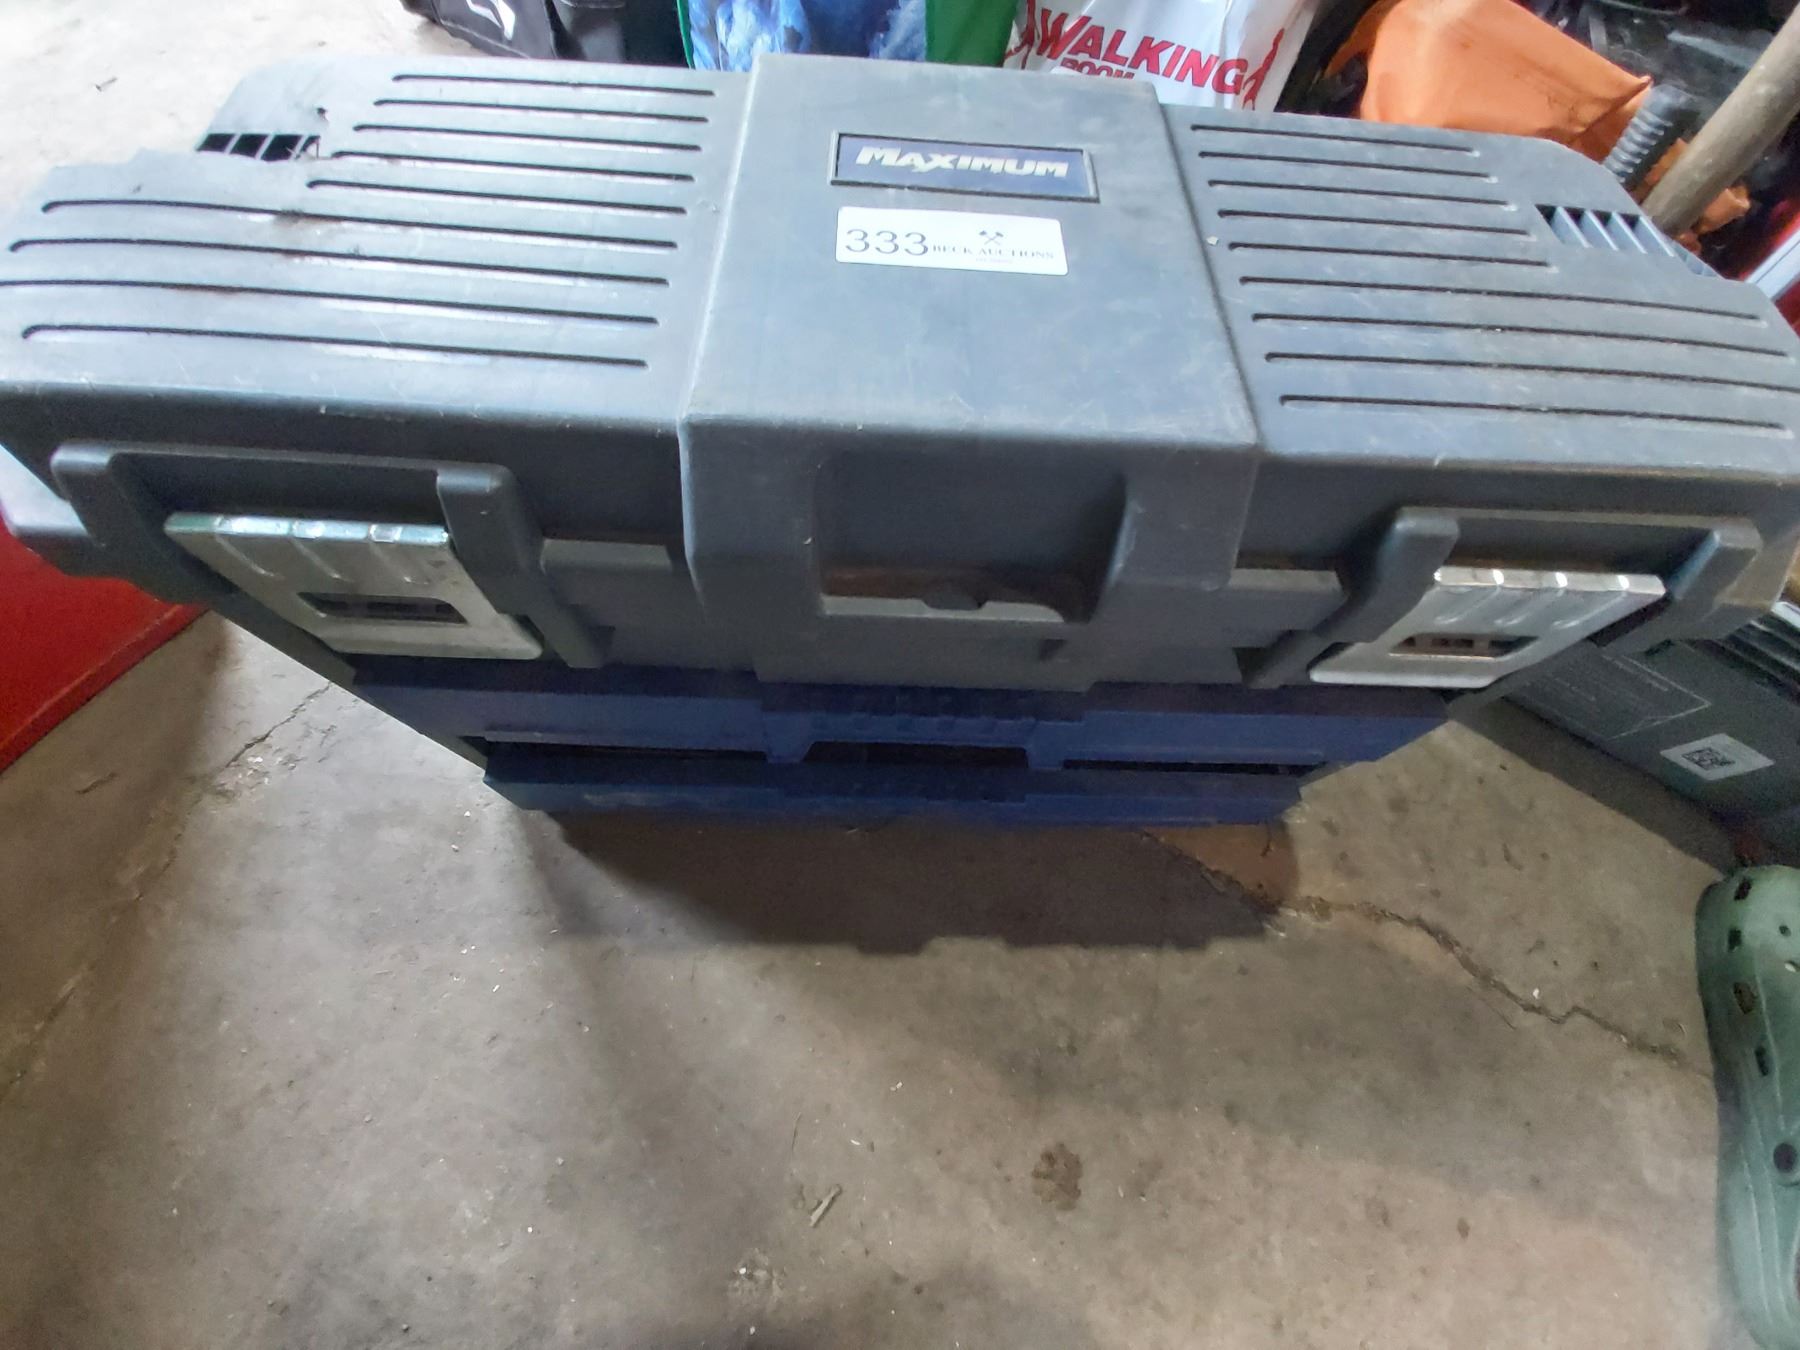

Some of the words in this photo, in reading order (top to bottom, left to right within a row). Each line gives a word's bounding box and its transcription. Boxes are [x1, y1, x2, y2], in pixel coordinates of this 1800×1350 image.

[1036, 8, 1248, 95] WALKING
[856, 146, 1068, 178] MAXIMUM
[845, 228, 928, 256] 333
[933, 244, 973, 255] BECK
[978, 247, 1054, 260] AUCTIONS
